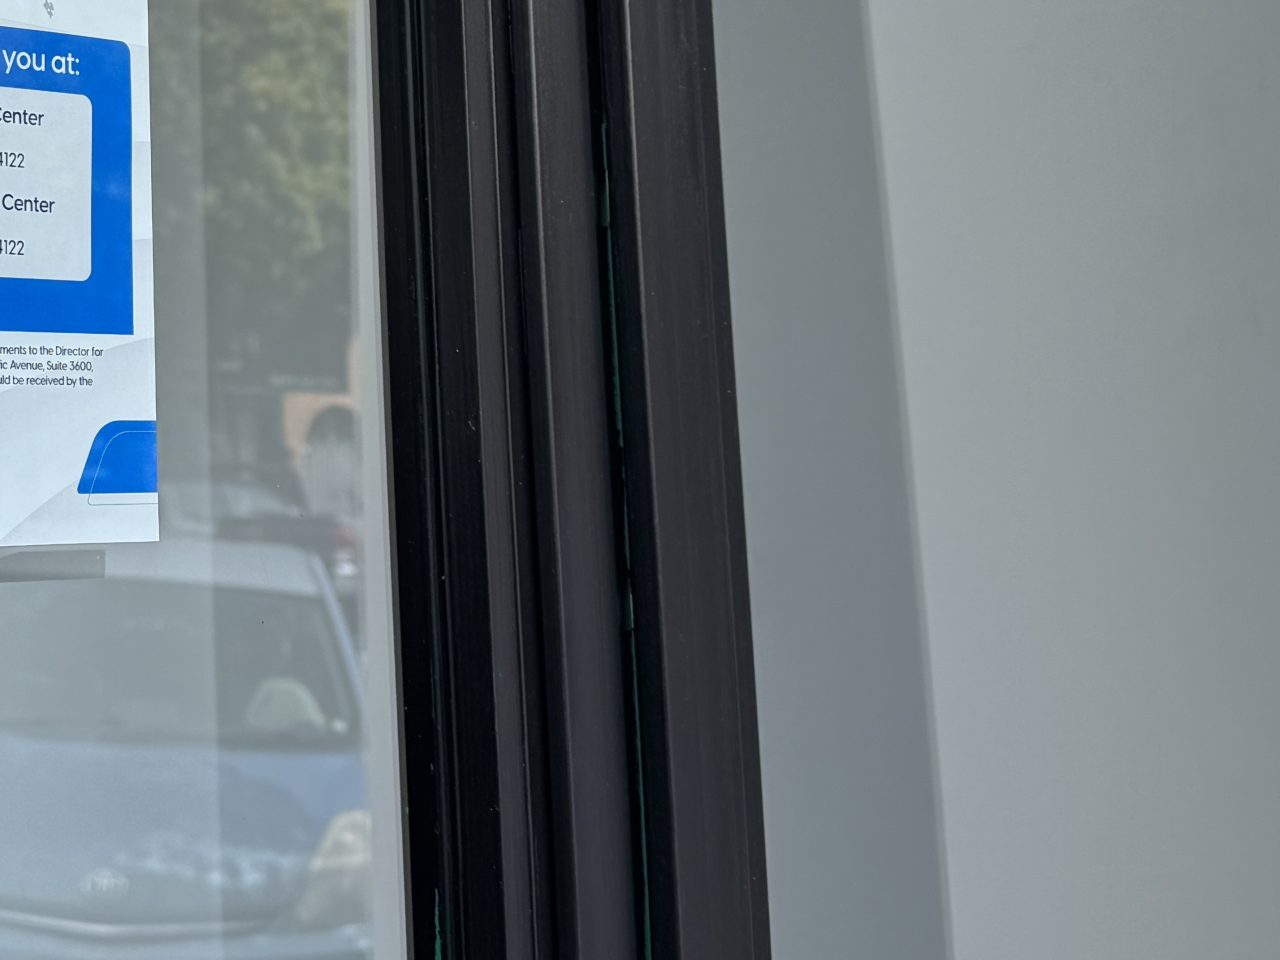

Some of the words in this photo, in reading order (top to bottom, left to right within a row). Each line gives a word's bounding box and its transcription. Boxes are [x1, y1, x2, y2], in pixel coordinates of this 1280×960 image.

[2, 50, 45, 73] you
[52, 53, 79, 75] at:
[2, 194, 55, 212] Center
[29, 346, 37, 354] to
[40, 346, 53, 355] the
[56, 346, 89, 356] Director
[92, 347, 103, 356] for
[10, 360, 44, 371] Avenue,
[47, 361, 67, 370] Suite
[70, 361, 93, 372] 3600,
[13, 376, 24, 384] be
[26, 376, 64, 385] received
[66, 377, 76, 387] by
[79, 376, 93, 386] the
